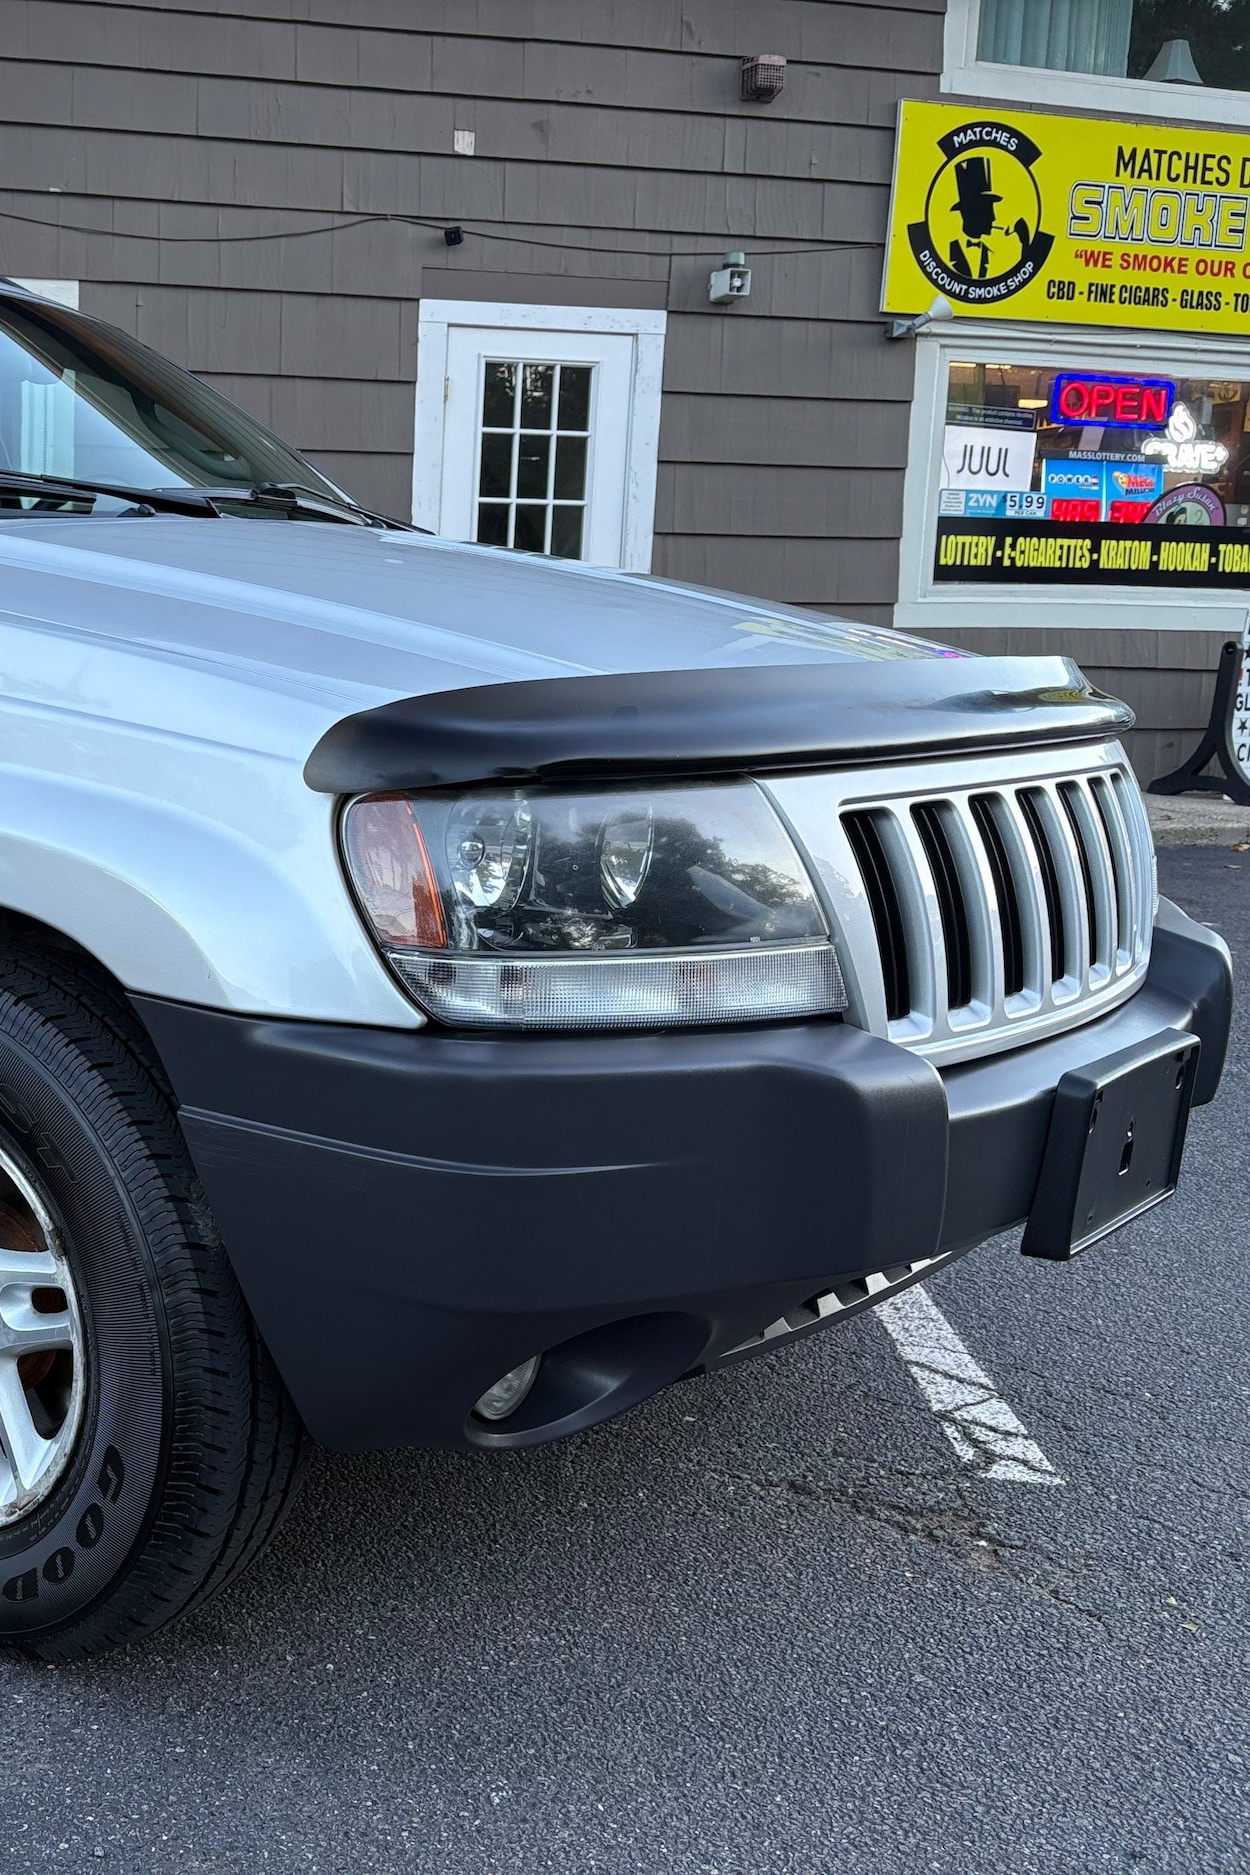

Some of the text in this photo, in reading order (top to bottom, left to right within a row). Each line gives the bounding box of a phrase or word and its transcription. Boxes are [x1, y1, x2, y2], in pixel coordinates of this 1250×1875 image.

[953, 127, 1018, 151] MATCHES
[1115, 145, 1232, 187] MATCHES
[1066, 180, 1250, 252] SMOKE
[919, 250, 1035, 299] DISCOUNT SMOKE SHOP
[1119, 252, 1189, 275] SMOKE
[1195, 258, 1237, 279] OUR
[1046, 279, 1076, 301] CBD
[1086, 282, 1116, 304] FINE
[1118, 284, 1169, 308] CIGARS
[1180, 289, 1222, 312] GLASS
[1059, 381, 1167, 422] OPEN
[956, 444, 1010, 478] JUUL
[1068, 450, 1146, 463] MASSLOTTERY.COM
[968, 493, 998, 507] ZYN
[1153, 486, 1217, 517] Blazy Susan
[939, 534, 997, 566] LOTTERY
[1002, 536, 1092, 568] E-CIGARETTES
[1098, 540, 1152, 570] KRATOM
[1158, 541, 1210, 572] HOOKAH
[1217, 543, 1250, 573] TOBA
